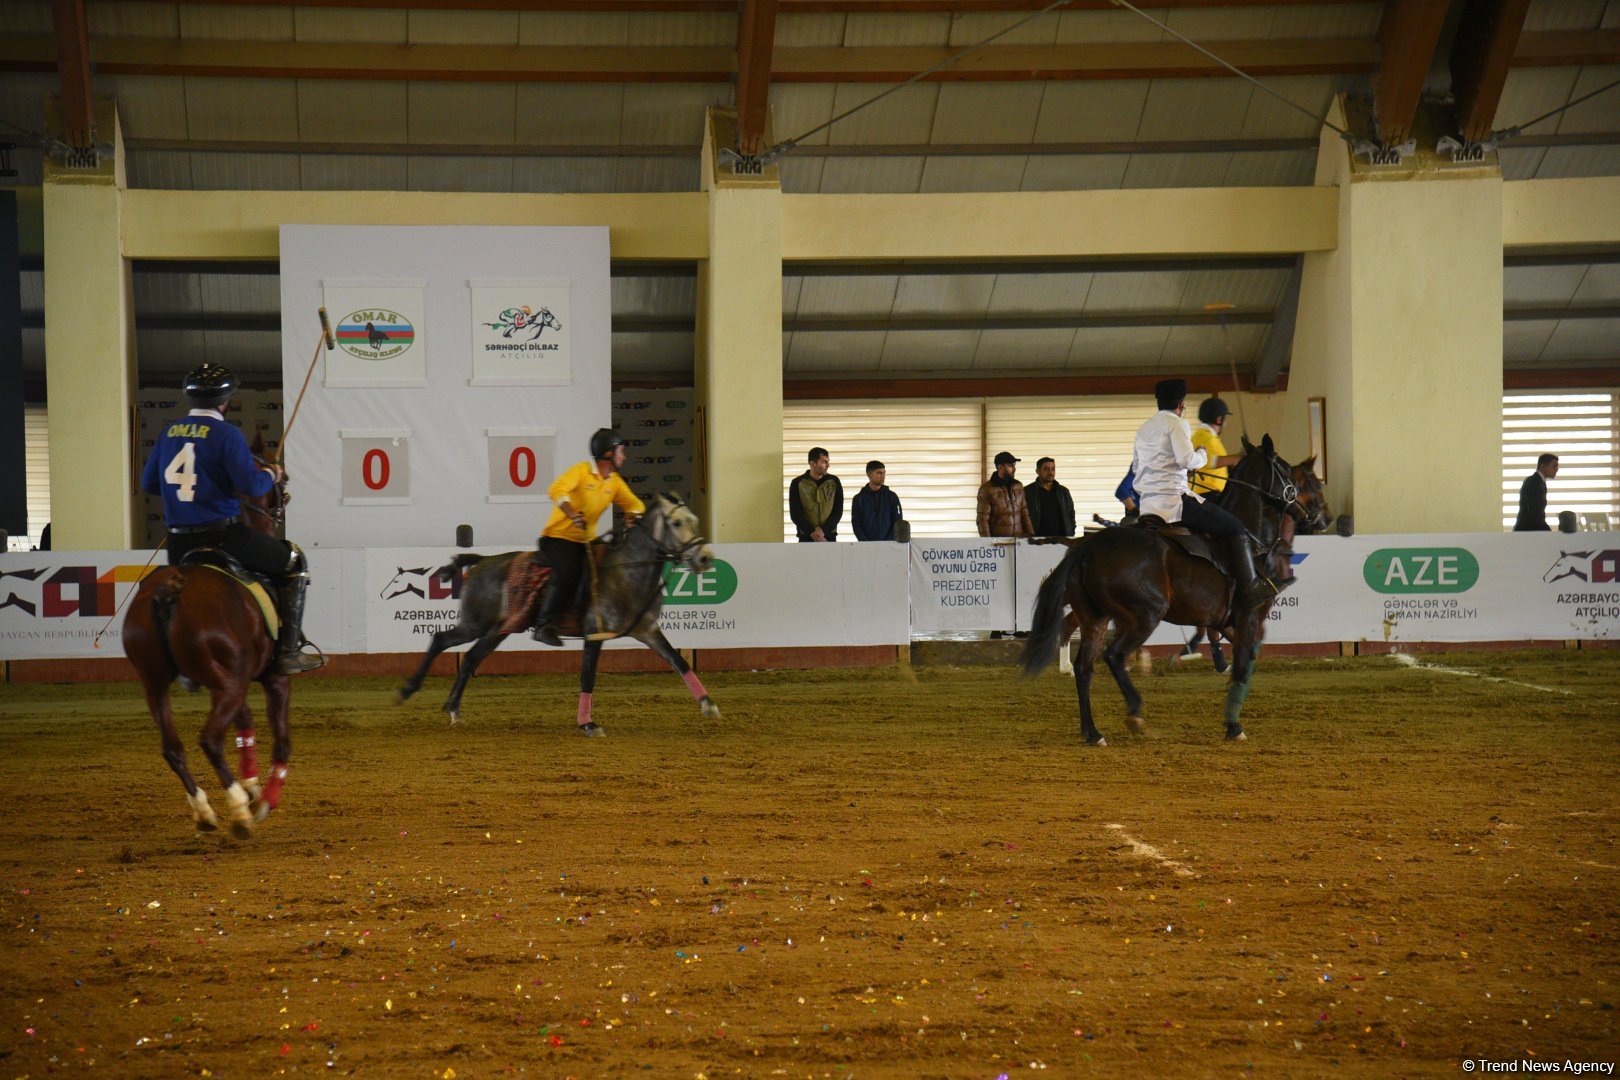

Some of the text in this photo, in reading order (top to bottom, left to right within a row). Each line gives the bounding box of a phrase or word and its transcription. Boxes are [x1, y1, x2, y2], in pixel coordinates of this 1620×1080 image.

[352, 312, 397, 324] OMAR
[485, 343, 559, 352] SƏRHƏDÇİ DİLBAZ
[167, 424, 210, 439] OMAR
[164, 442, 198, 502] 4
[362, 449, 390, 490] 0
[509, 447, 536, 487] 0
[922, 546, 1006, 562] ÇÖVKƏN ATÜSTÜ
[932, 561, 997, 574] OYUNU ÜZRƏ
[1384, 556, 1458, 585] AZE
[932, 578, 997, 591] PREZİDENT
[941, 595, 990, 606] KUBOKU
[1384, 599, 1458, 608] GƏNCLƏR VƏ
[701, 610, 717, 619] VƏ
[1424, 608, 1477, 619] NAZİRLİYİ
[683, 618, 735, 630] NAZİRLİYİ
